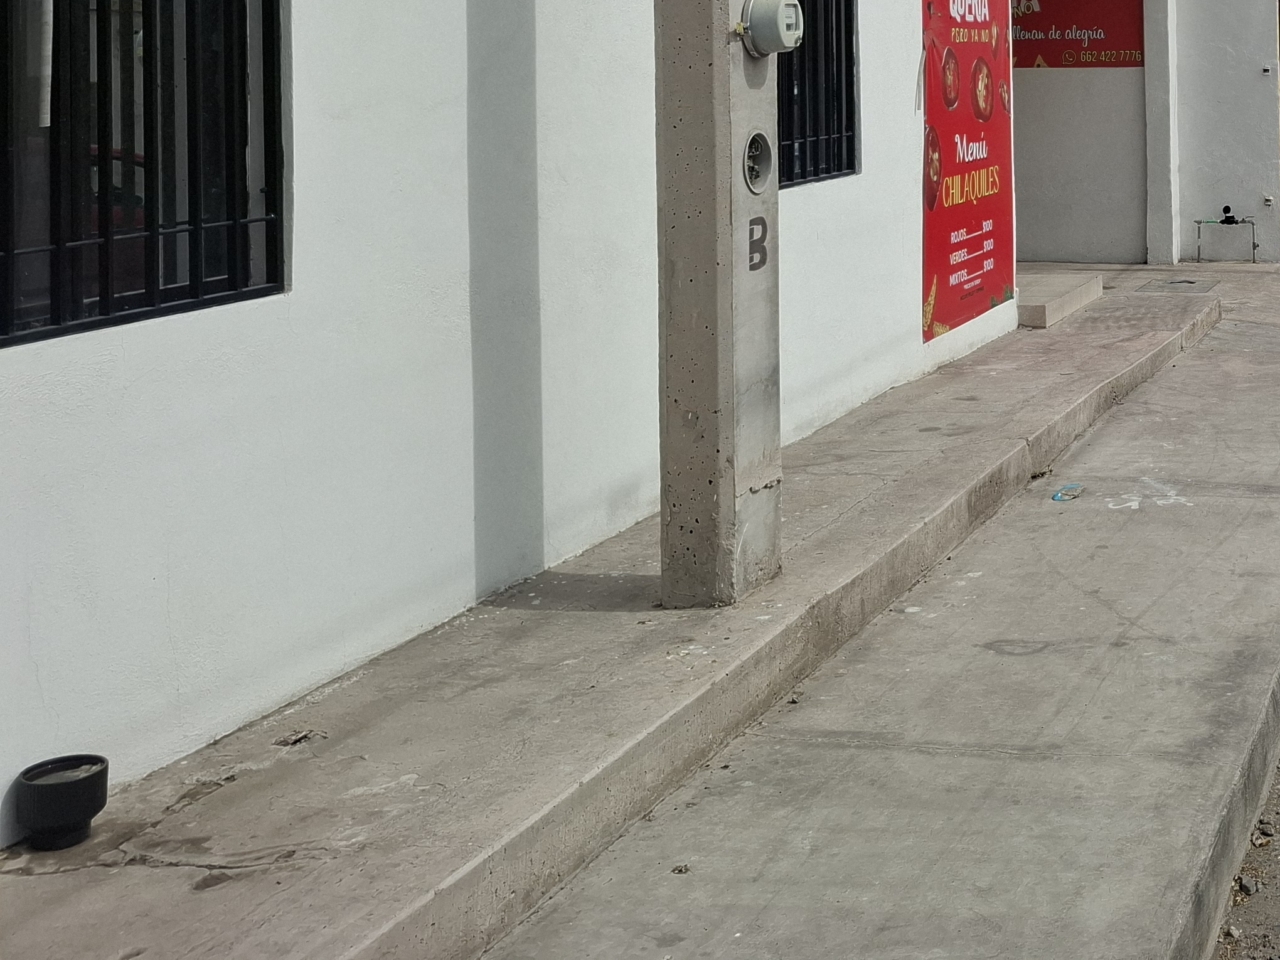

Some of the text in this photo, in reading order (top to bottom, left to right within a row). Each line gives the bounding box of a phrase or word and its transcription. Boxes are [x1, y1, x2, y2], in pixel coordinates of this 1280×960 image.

[971, 28, 979, 43] YA
[981, 29, 990, 43] NO
[1048, 25, 1062, 40] de
[1064, 25, 1106, 48] alegría
[1080, 50, 1142, 62] 662 422 7776
[954, 131, 989, 164] Menú
[942, 165, 1000, 208] CHILAQUILES
[748, 215, 769, 272] B
